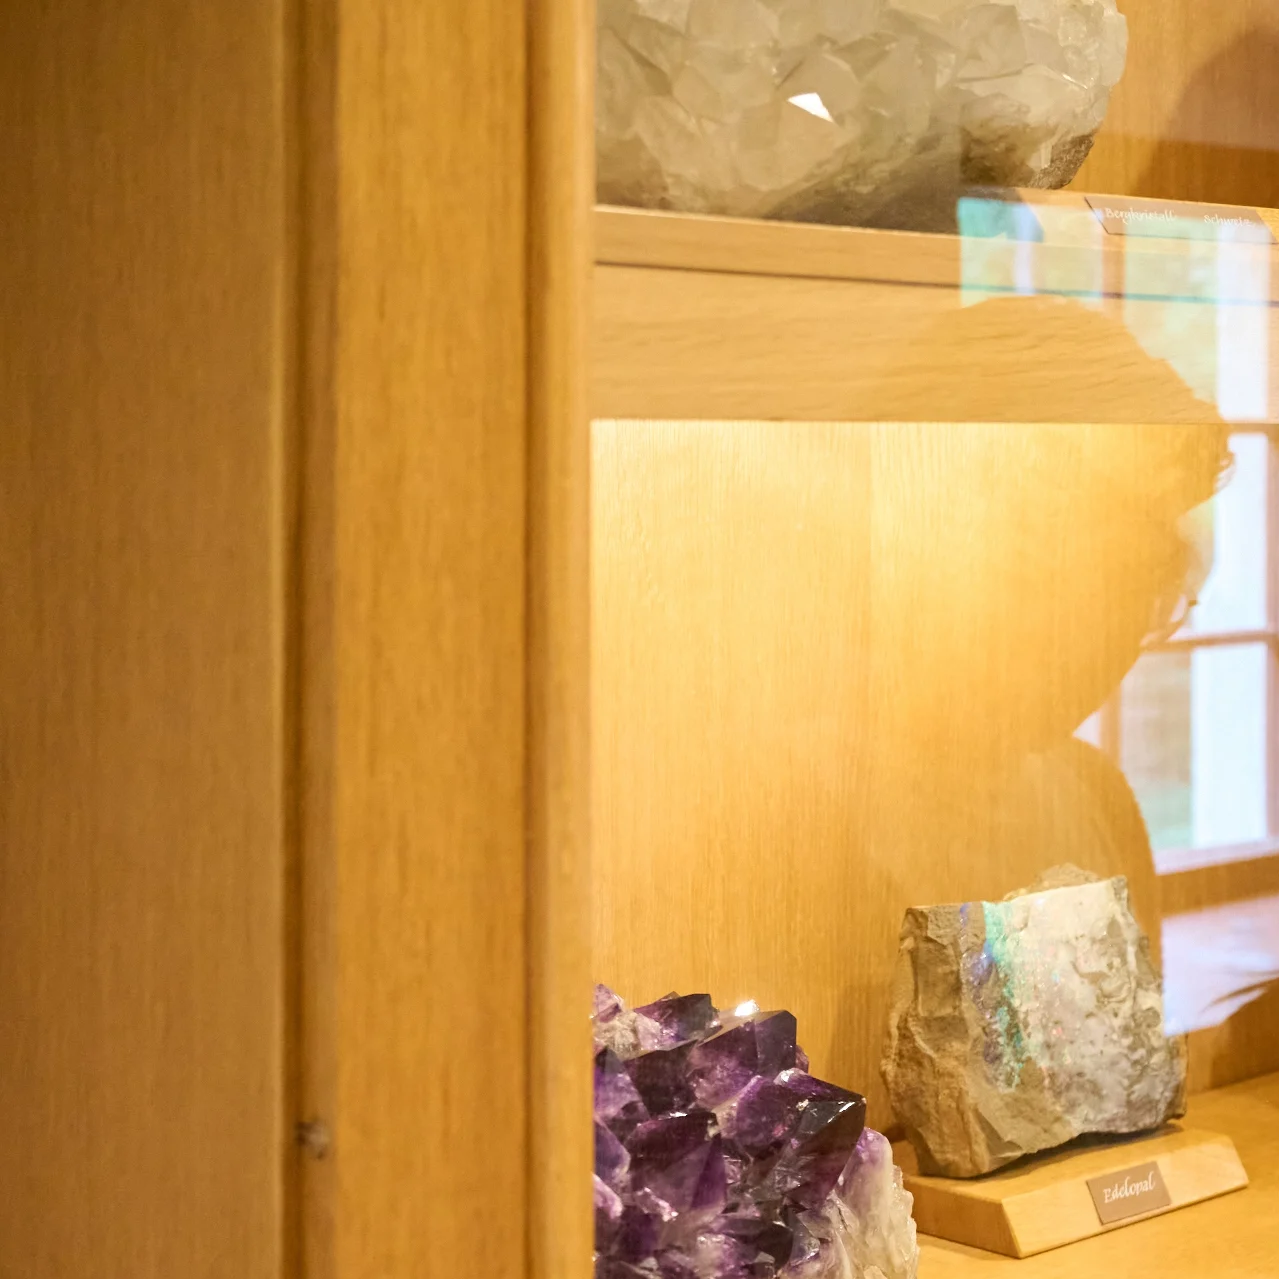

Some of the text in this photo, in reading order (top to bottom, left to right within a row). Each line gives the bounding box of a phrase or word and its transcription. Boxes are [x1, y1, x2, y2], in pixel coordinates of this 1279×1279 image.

[1104, 206, 1256, 228] Bergkristall Schweiz
[1102, 1170, 1156, 1204] Edelopal
